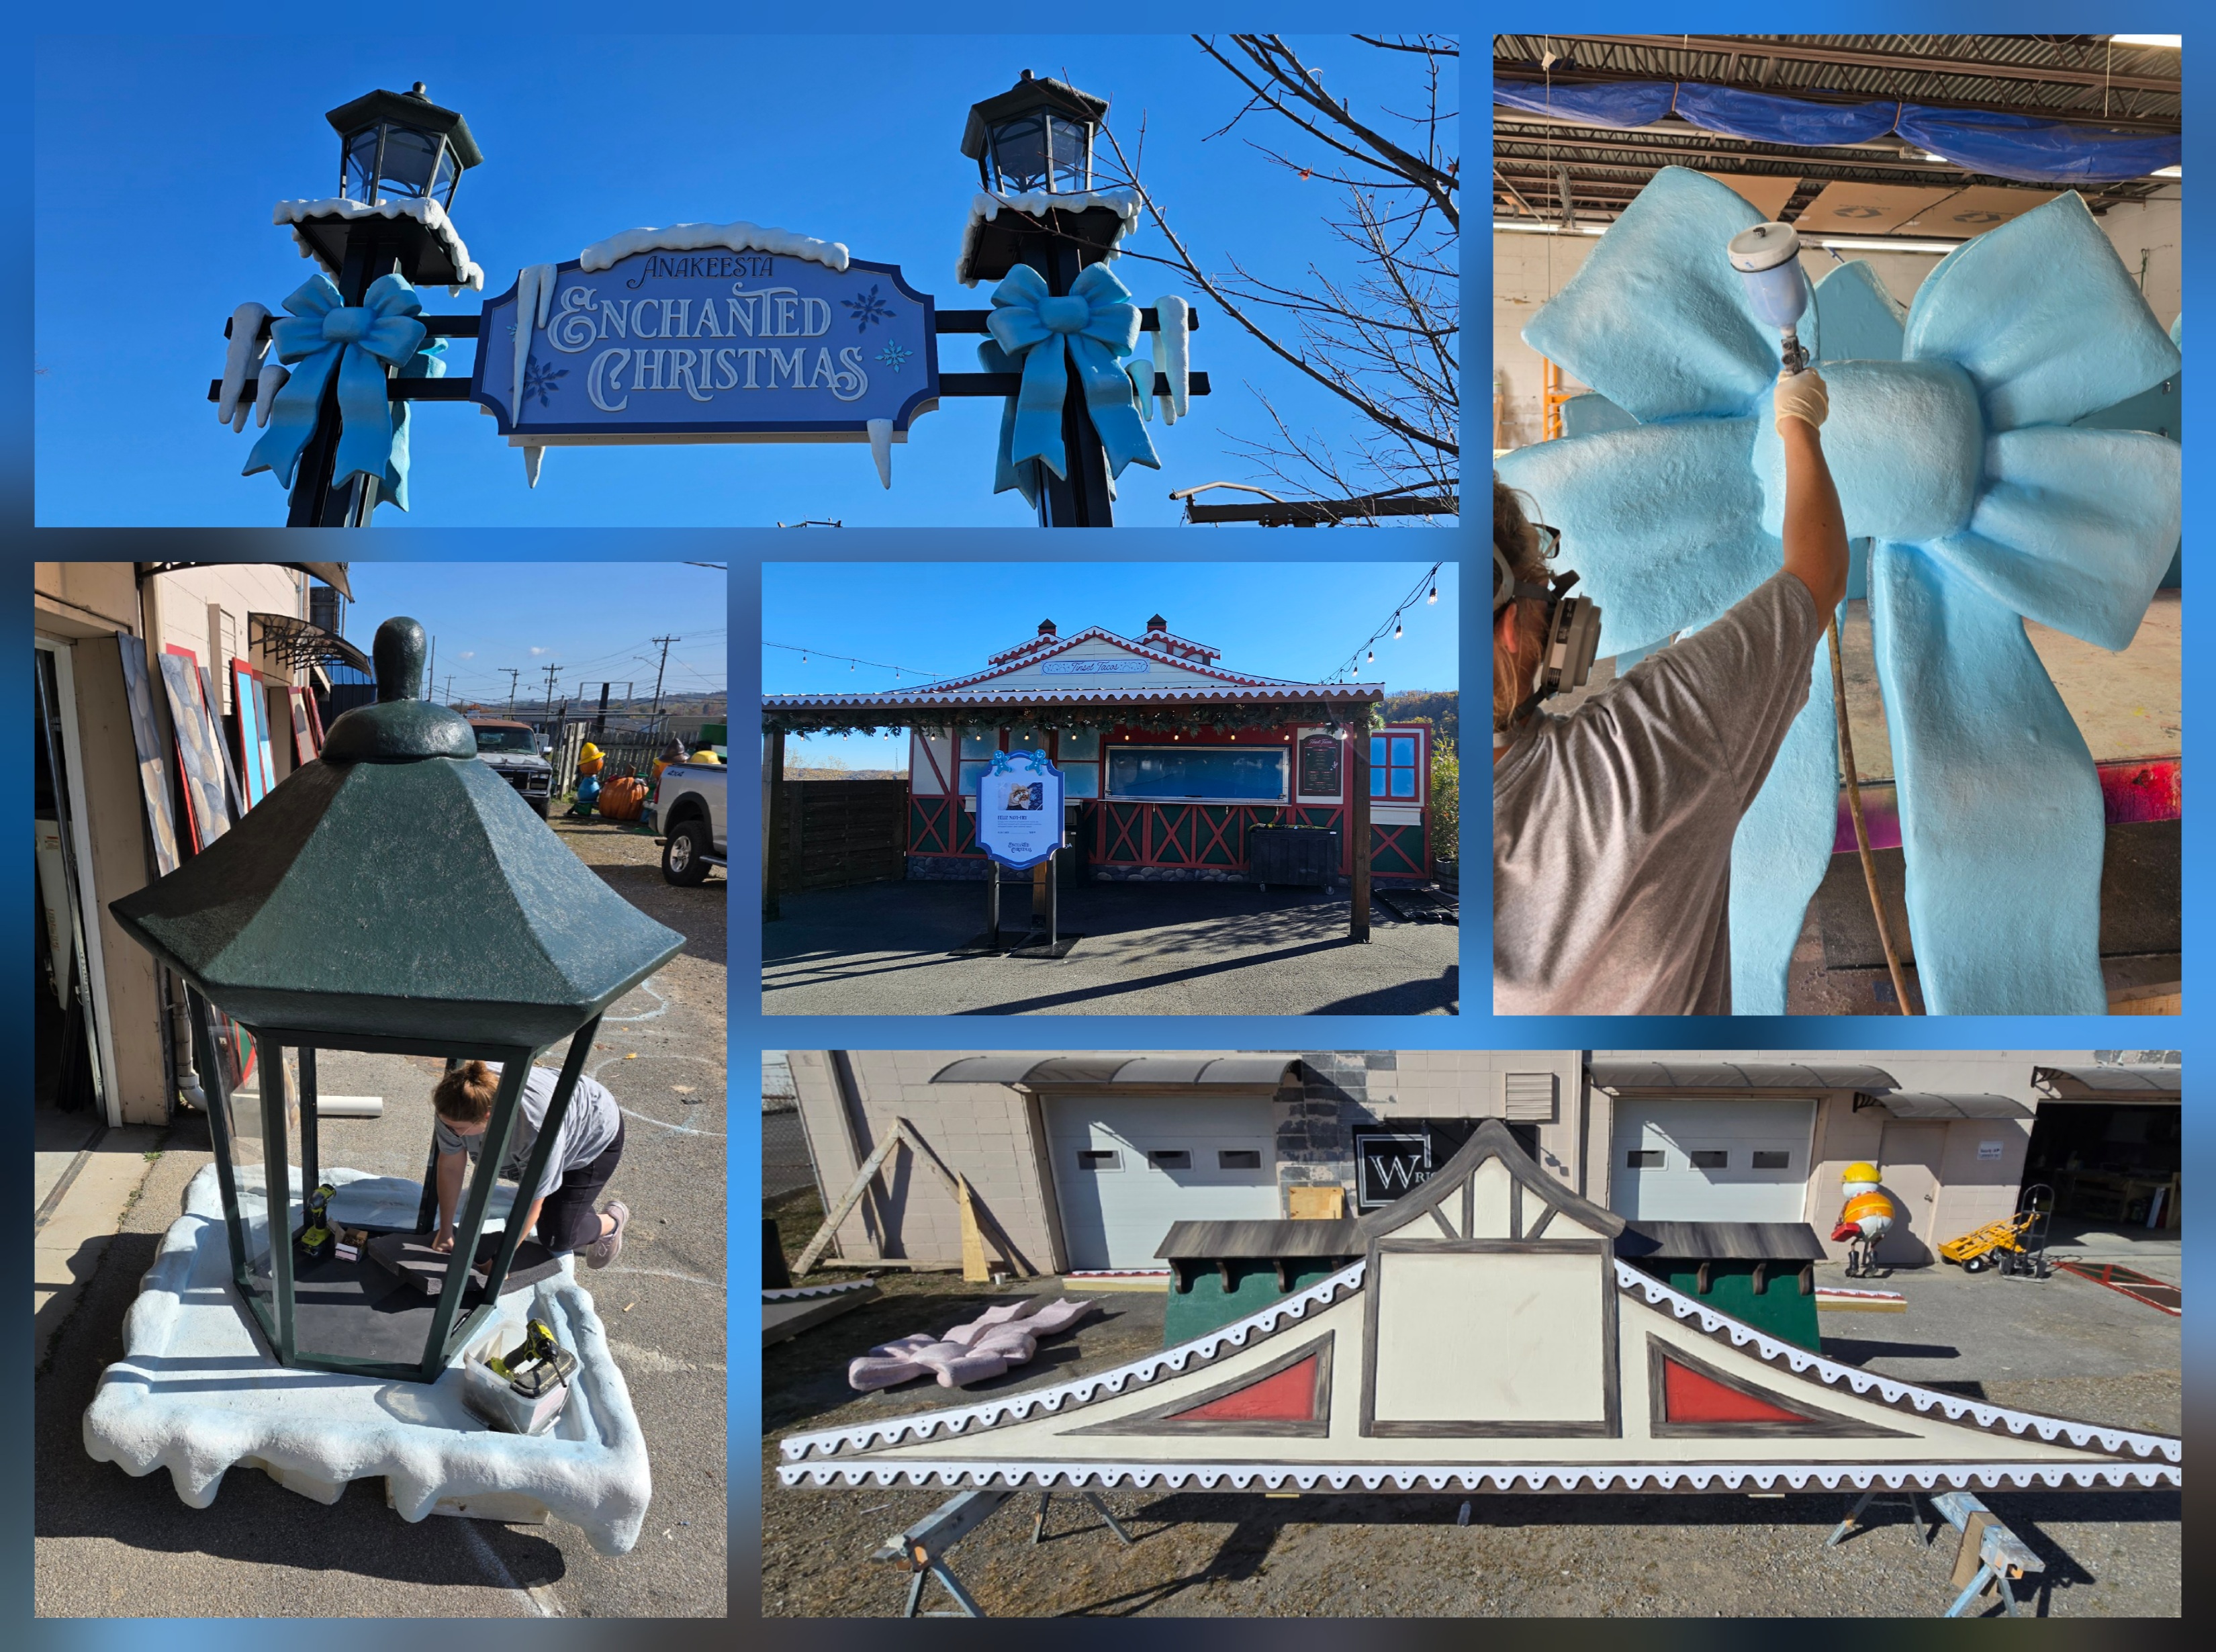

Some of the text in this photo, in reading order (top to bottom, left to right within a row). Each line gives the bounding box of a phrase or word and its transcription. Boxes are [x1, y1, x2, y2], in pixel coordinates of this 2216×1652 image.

[626, 255, 774, 290] ANAKEESTA
[547, 282, 833, 353] ENCHANTED
[587, 346, 870, 413] CHRISTMAS
[1070, 661, 1120, 673] Tinsel Tacos
